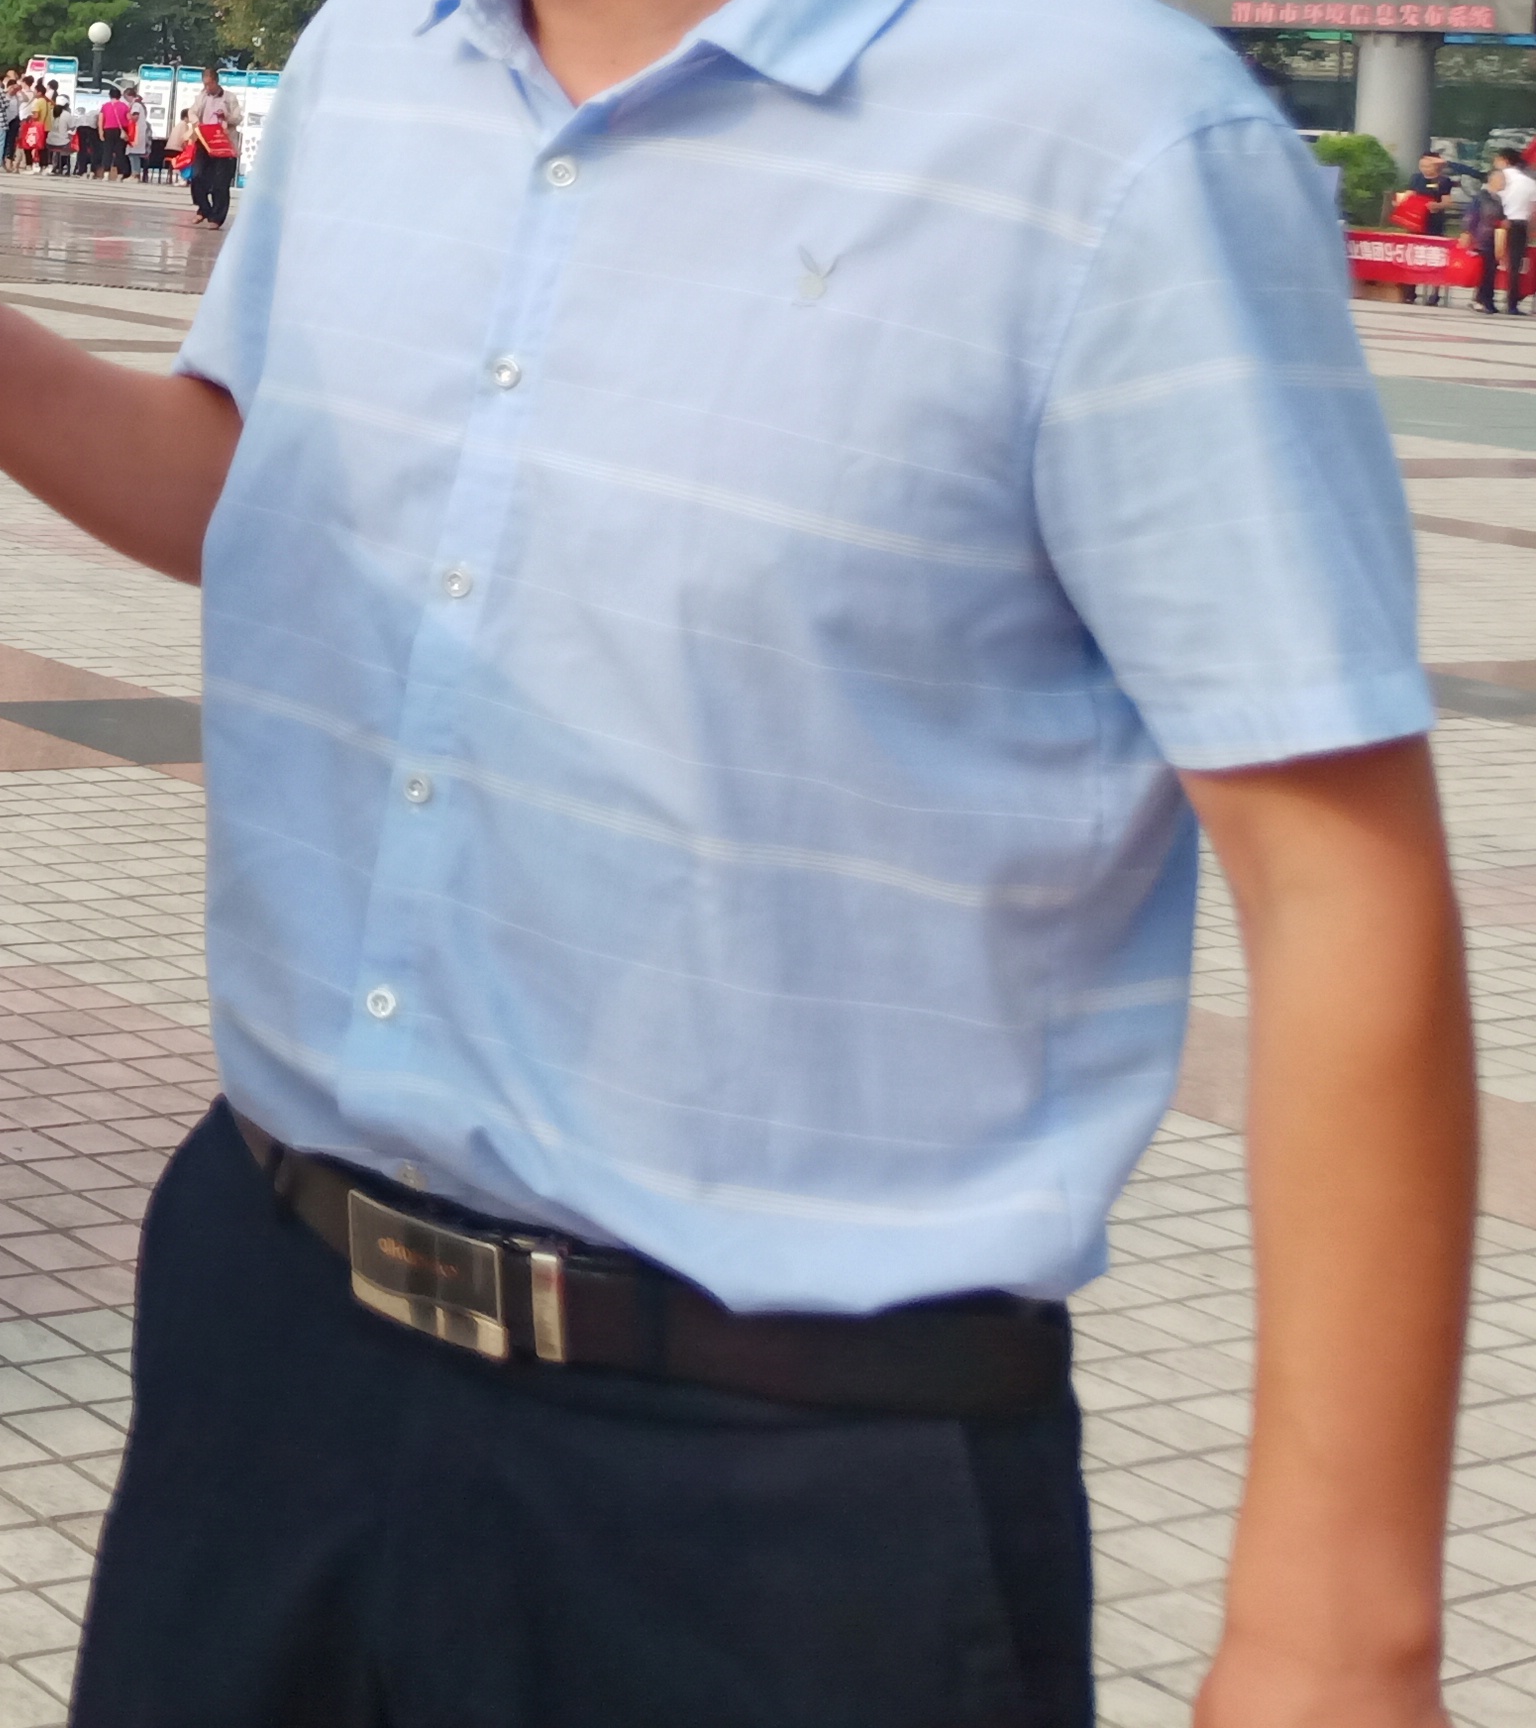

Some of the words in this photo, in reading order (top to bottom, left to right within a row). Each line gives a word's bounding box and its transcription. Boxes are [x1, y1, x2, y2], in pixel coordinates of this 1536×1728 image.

[1231, 1, 1497, 29] 渭南市环境信息发布系统
